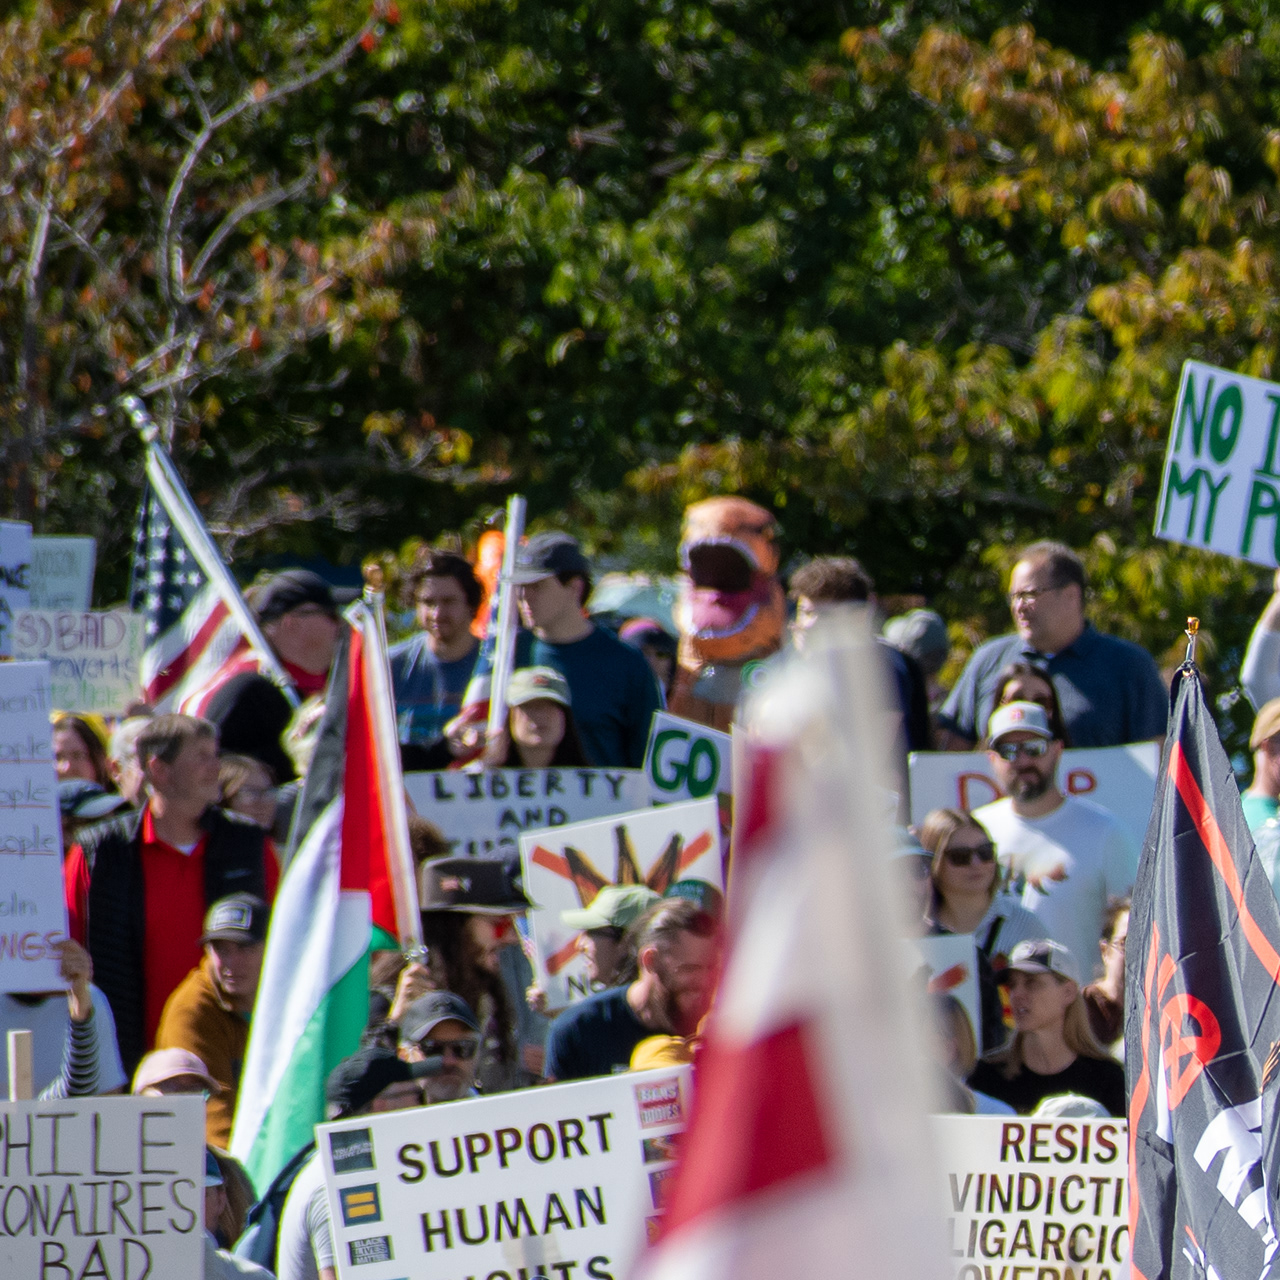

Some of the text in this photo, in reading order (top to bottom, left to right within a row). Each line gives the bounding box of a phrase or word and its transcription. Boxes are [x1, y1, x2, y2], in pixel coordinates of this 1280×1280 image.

[1174, 373, 1242, 465] NO
[1161, 461, 1230, 544] MY
[432, 771, 629, 801] LIBERTY
[498, 808, 570, 829] AND
[0, 931, 66, 961] NGS
[0, 1111, 179, 1178] HILE
[396, 1112, 615, 1185] SUPPORT
[1000, 1122, 1129, 1164] RESIS
[0, 1179, 198, 1238] ONAIRES
[420, 1186, 609, 1253] HUMAN
[353, 1245, 388, 1256] LIVES
